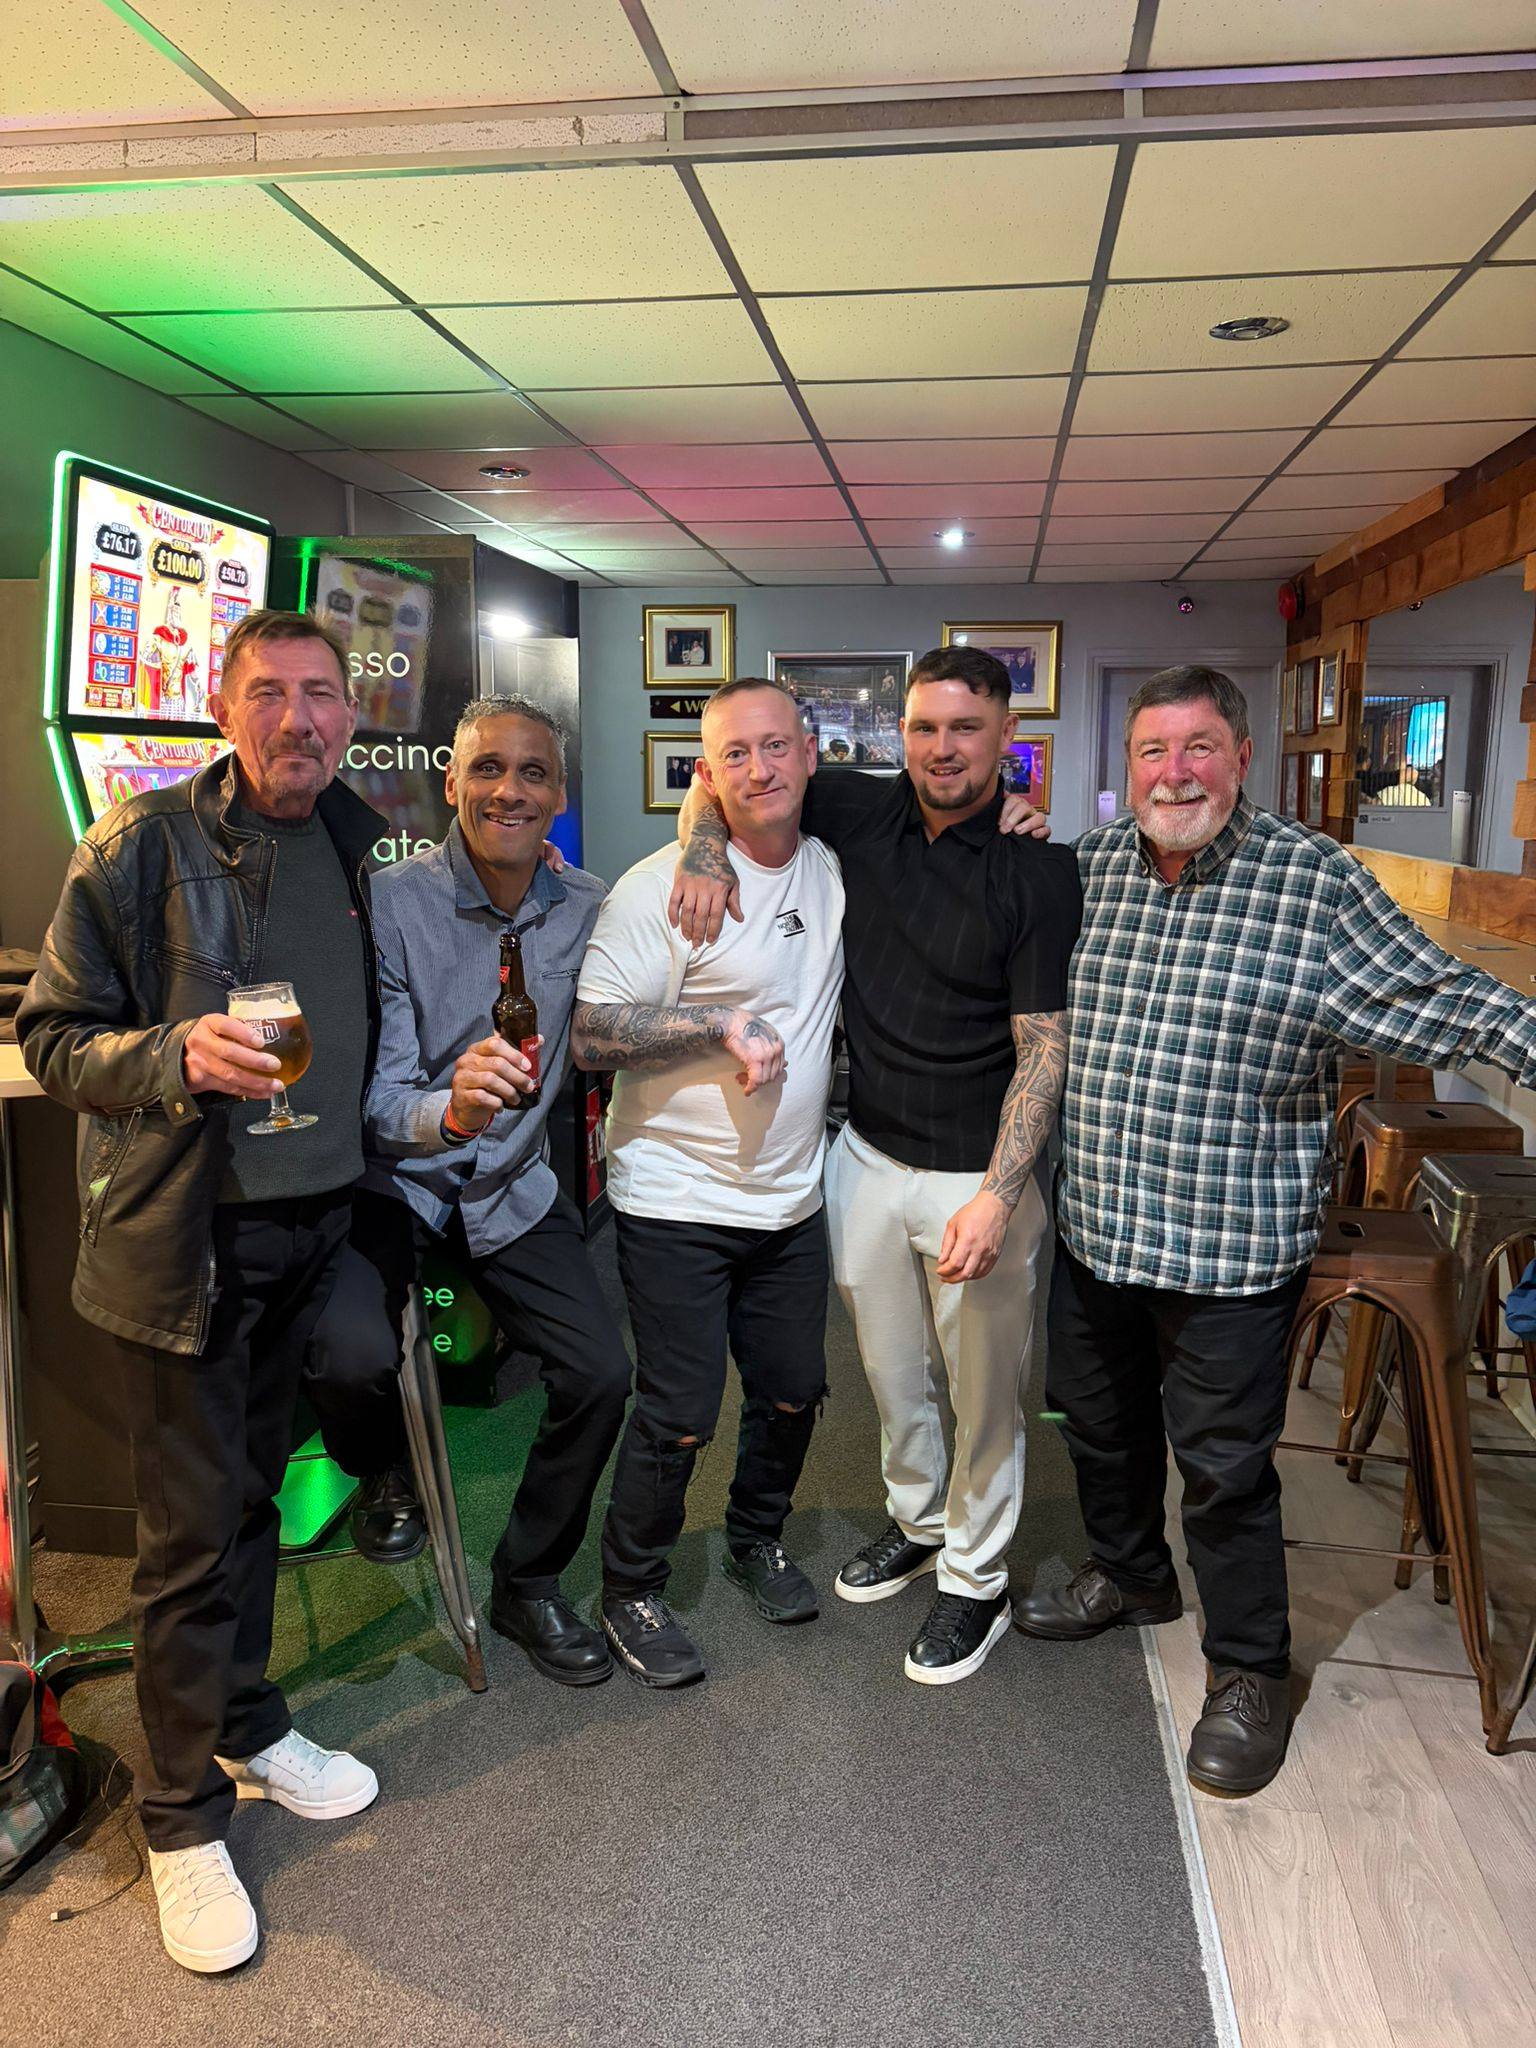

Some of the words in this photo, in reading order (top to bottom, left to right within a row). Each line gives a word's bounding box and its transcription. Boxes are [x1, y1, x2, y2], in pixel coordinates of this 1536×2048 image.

[152, 504, 212, 542] CENTURION
[101, 531, 137, 556] £76.17
[157, 549, 202, 580] £100.00
[348, 652, 410, 678] sso
[141, 738, 205, 762] CENTURION
[338, 735, 454, 771] ccino
[372, 829, 436, 862] ate
[423, 1286, 455, 1307] ee
